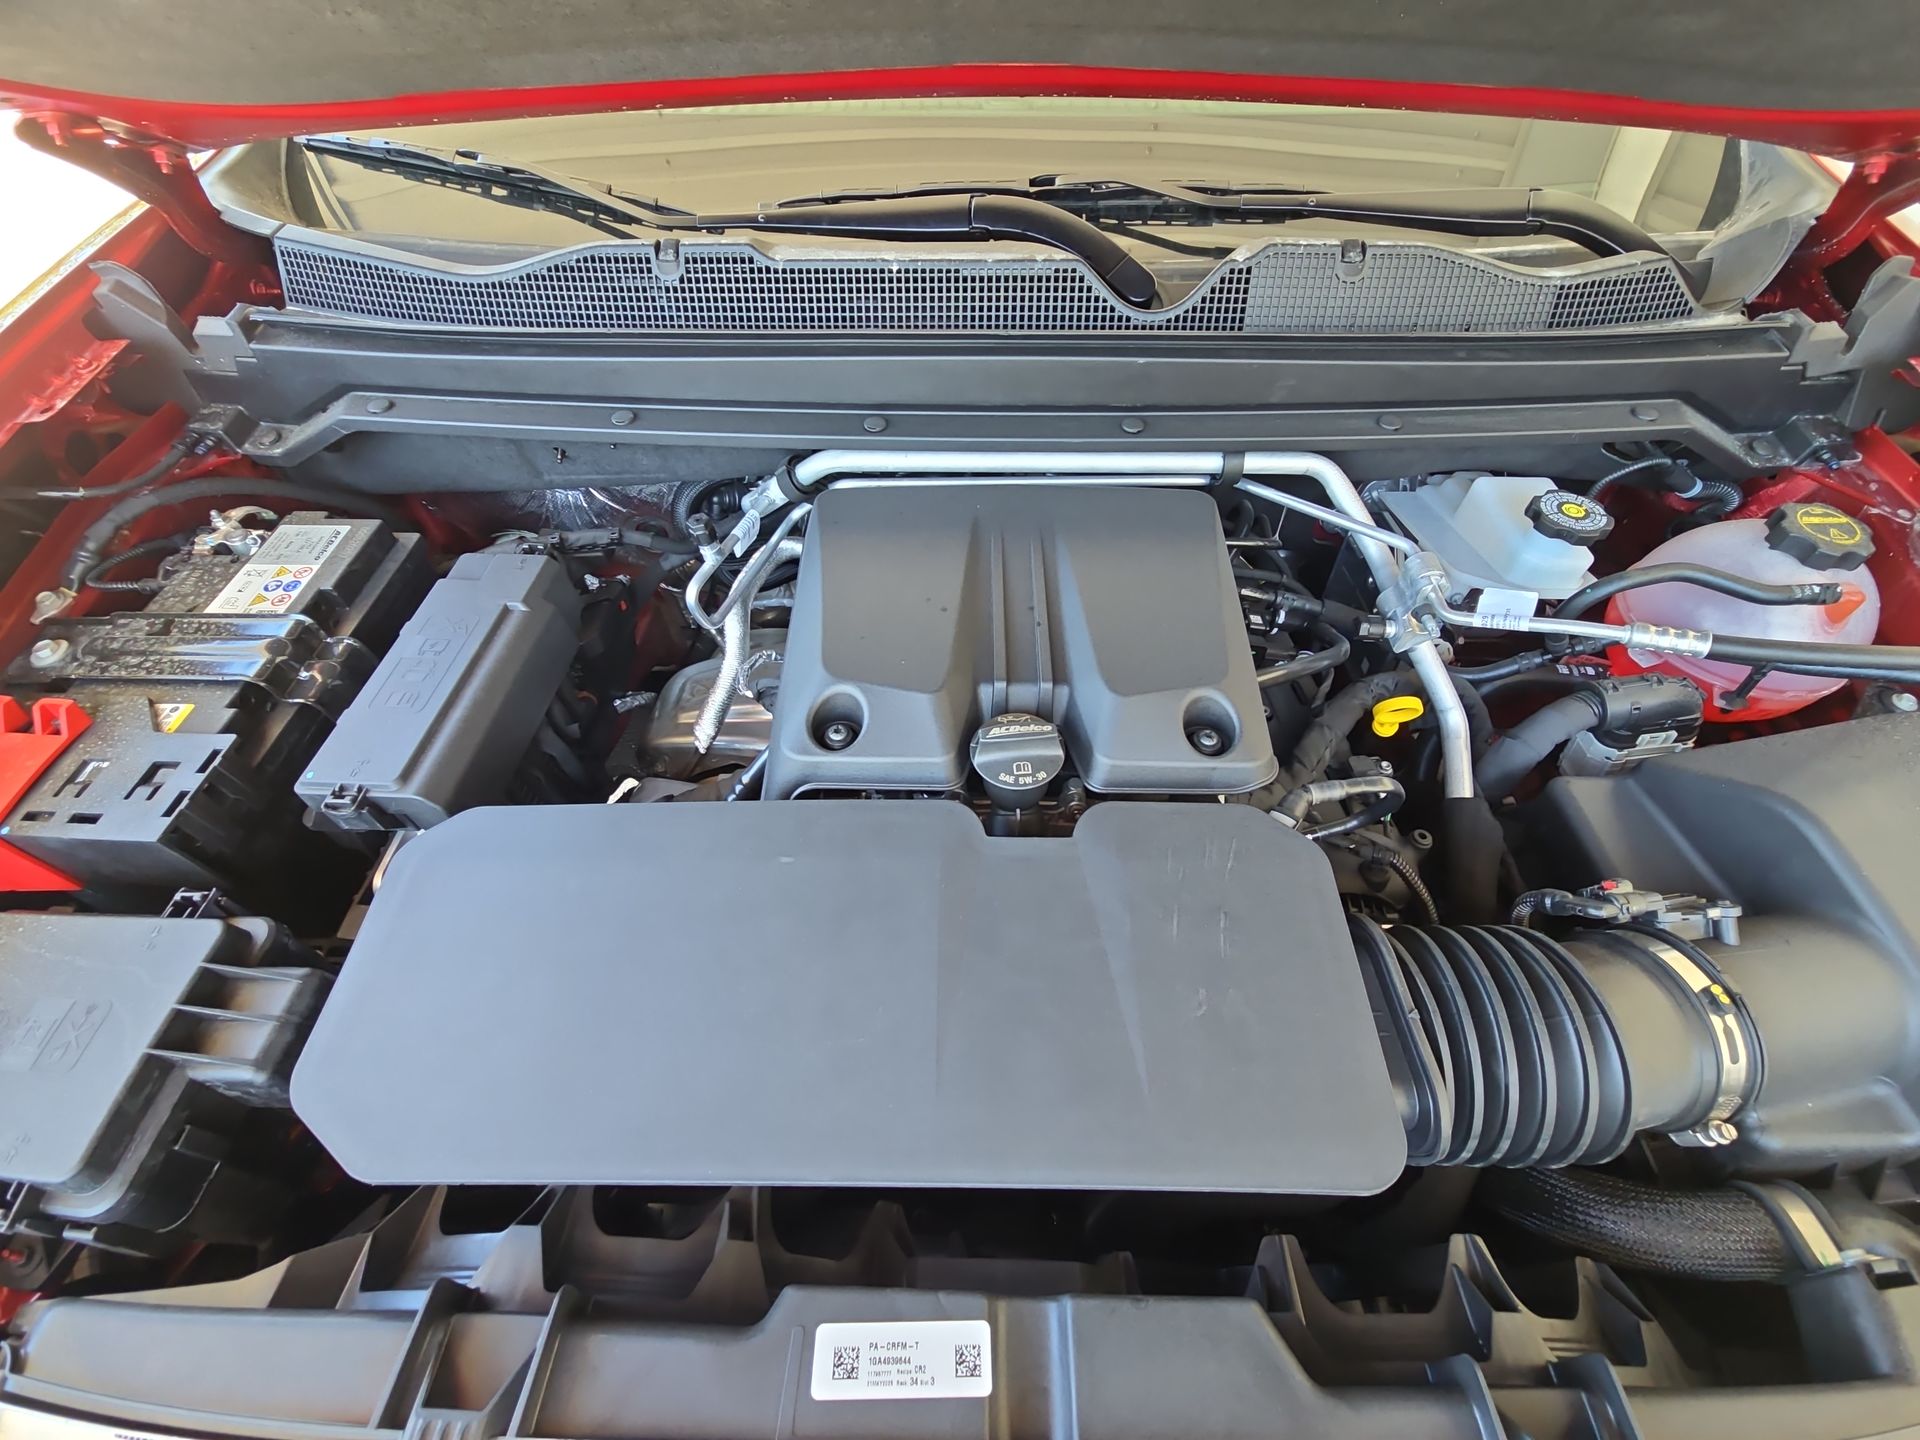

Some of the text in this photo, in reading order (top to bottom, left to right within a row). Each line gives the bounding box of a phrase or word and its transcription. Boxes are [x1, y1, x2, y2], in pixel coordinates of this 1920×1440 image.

[987, 724, 1053, 737] ACDelco
[998, 771, 1048, 785] SAE 5W-30
[869, 1341, 919, 1351] PA-CRFM-T
[914, 1365, 927, 1374] CR2
[910, 1377, 919, 1386] 34
[930, 1376, 935, 1386] 3
